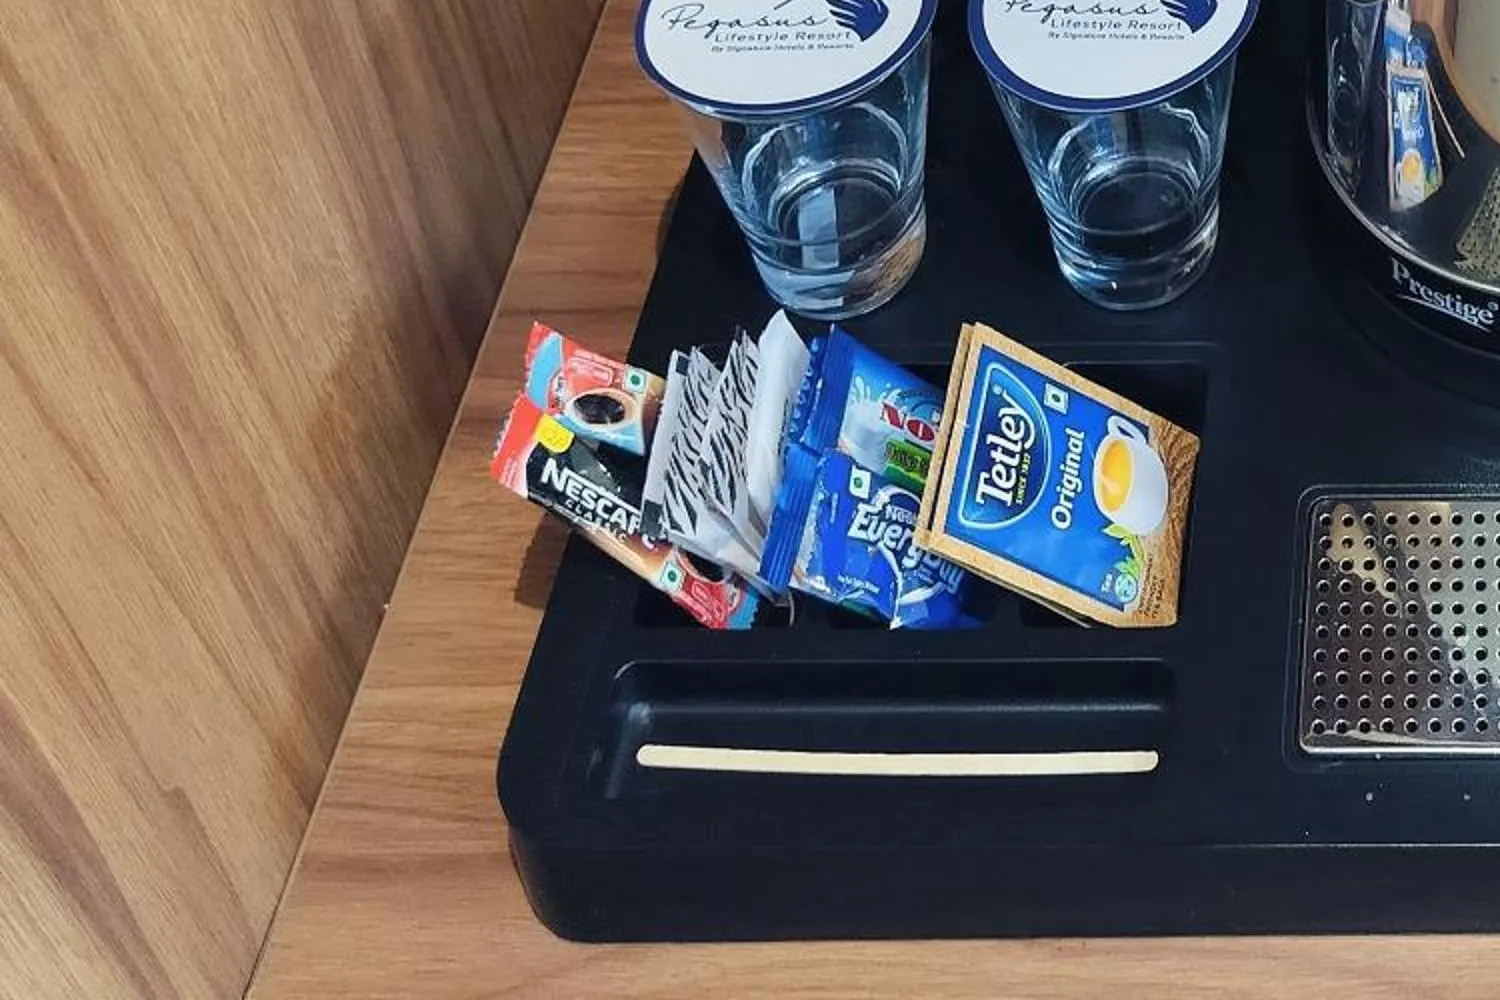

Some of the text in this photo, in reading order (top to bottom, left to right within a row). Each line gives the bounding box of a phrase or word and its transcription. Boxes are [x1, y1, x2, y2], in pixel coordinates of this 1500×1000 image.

[661, 3, 828, 39] Pegasus
[715, 31, 852, 42] Lifestyle Resort
[1051, 19, 1183, 31] Lifestyle Resort
[1390, 257, 1496, 325] Prestige
[976, 389, 1035, 507] Tetley
[1051, 427, 1085, 529] Original
[540, 457, 657, 550] NESCAF
